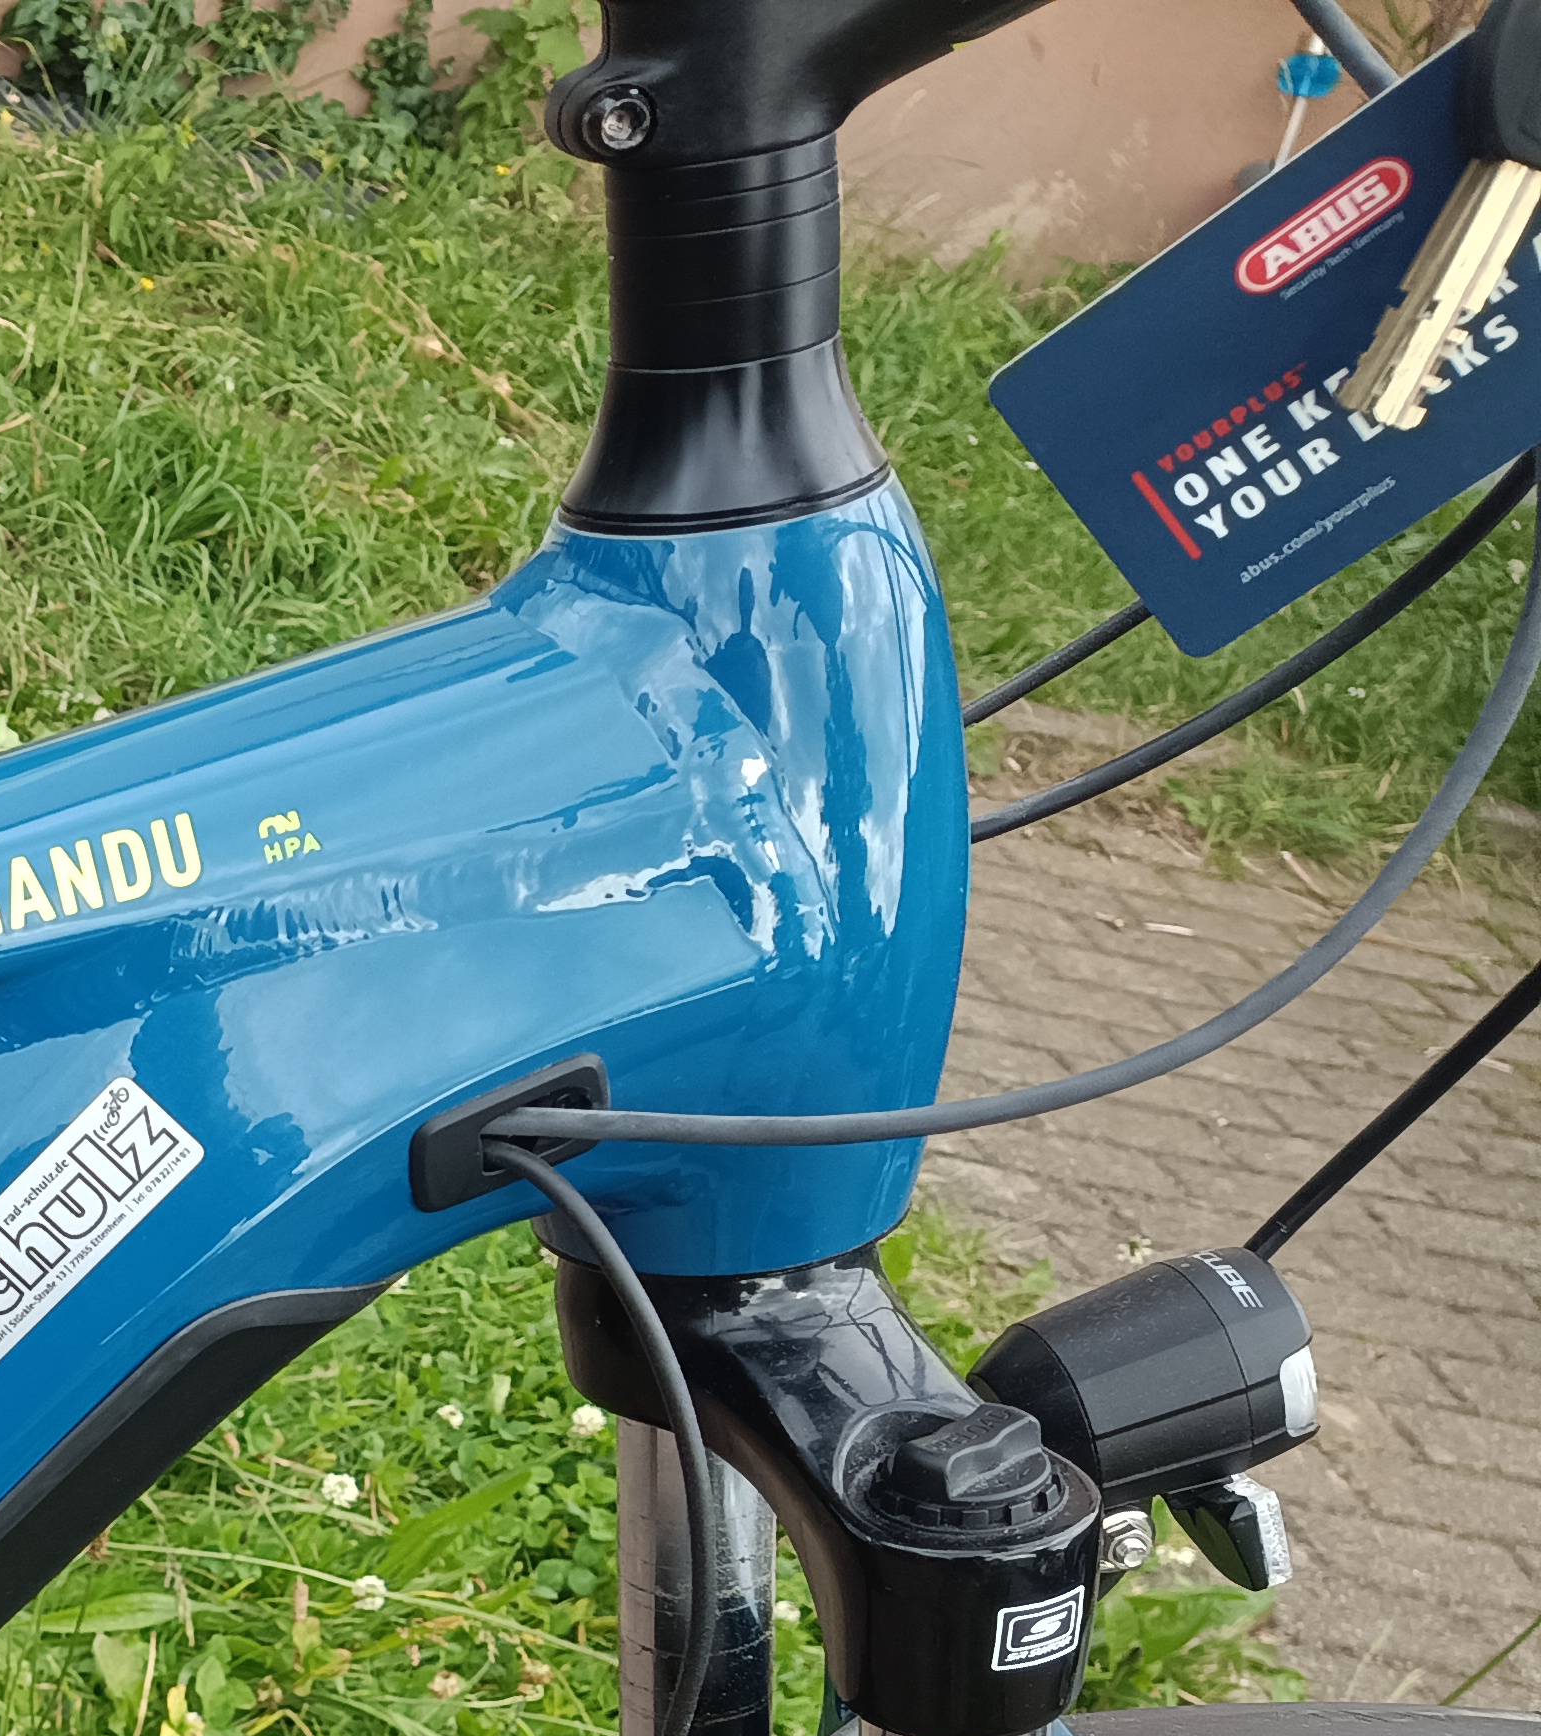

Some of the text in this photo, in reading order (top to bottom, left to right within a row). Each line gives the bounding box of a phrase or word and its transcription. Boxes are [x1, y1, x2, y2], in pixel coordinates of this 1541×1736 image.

[1260, 173, 1391, 280] ABUS
[1280, 264, 1327, 301] Security
[1352, 211, 1407, 252] Germany
[1173, 423, 1281, 507] ONE
[1193, 436, 1341, 540] YOUR
[1239, 475, 1397, 585] abus.com/yourplus
[263, 831, 322, 865] HPA
[2, 1157, 70, 1227] rad-schulz.de
[69, 1245, 93, 1269] 77955
[90, 1212, 127, 1248] Ettenheim
[1193, 1250, 1264, 1308] CUBE
